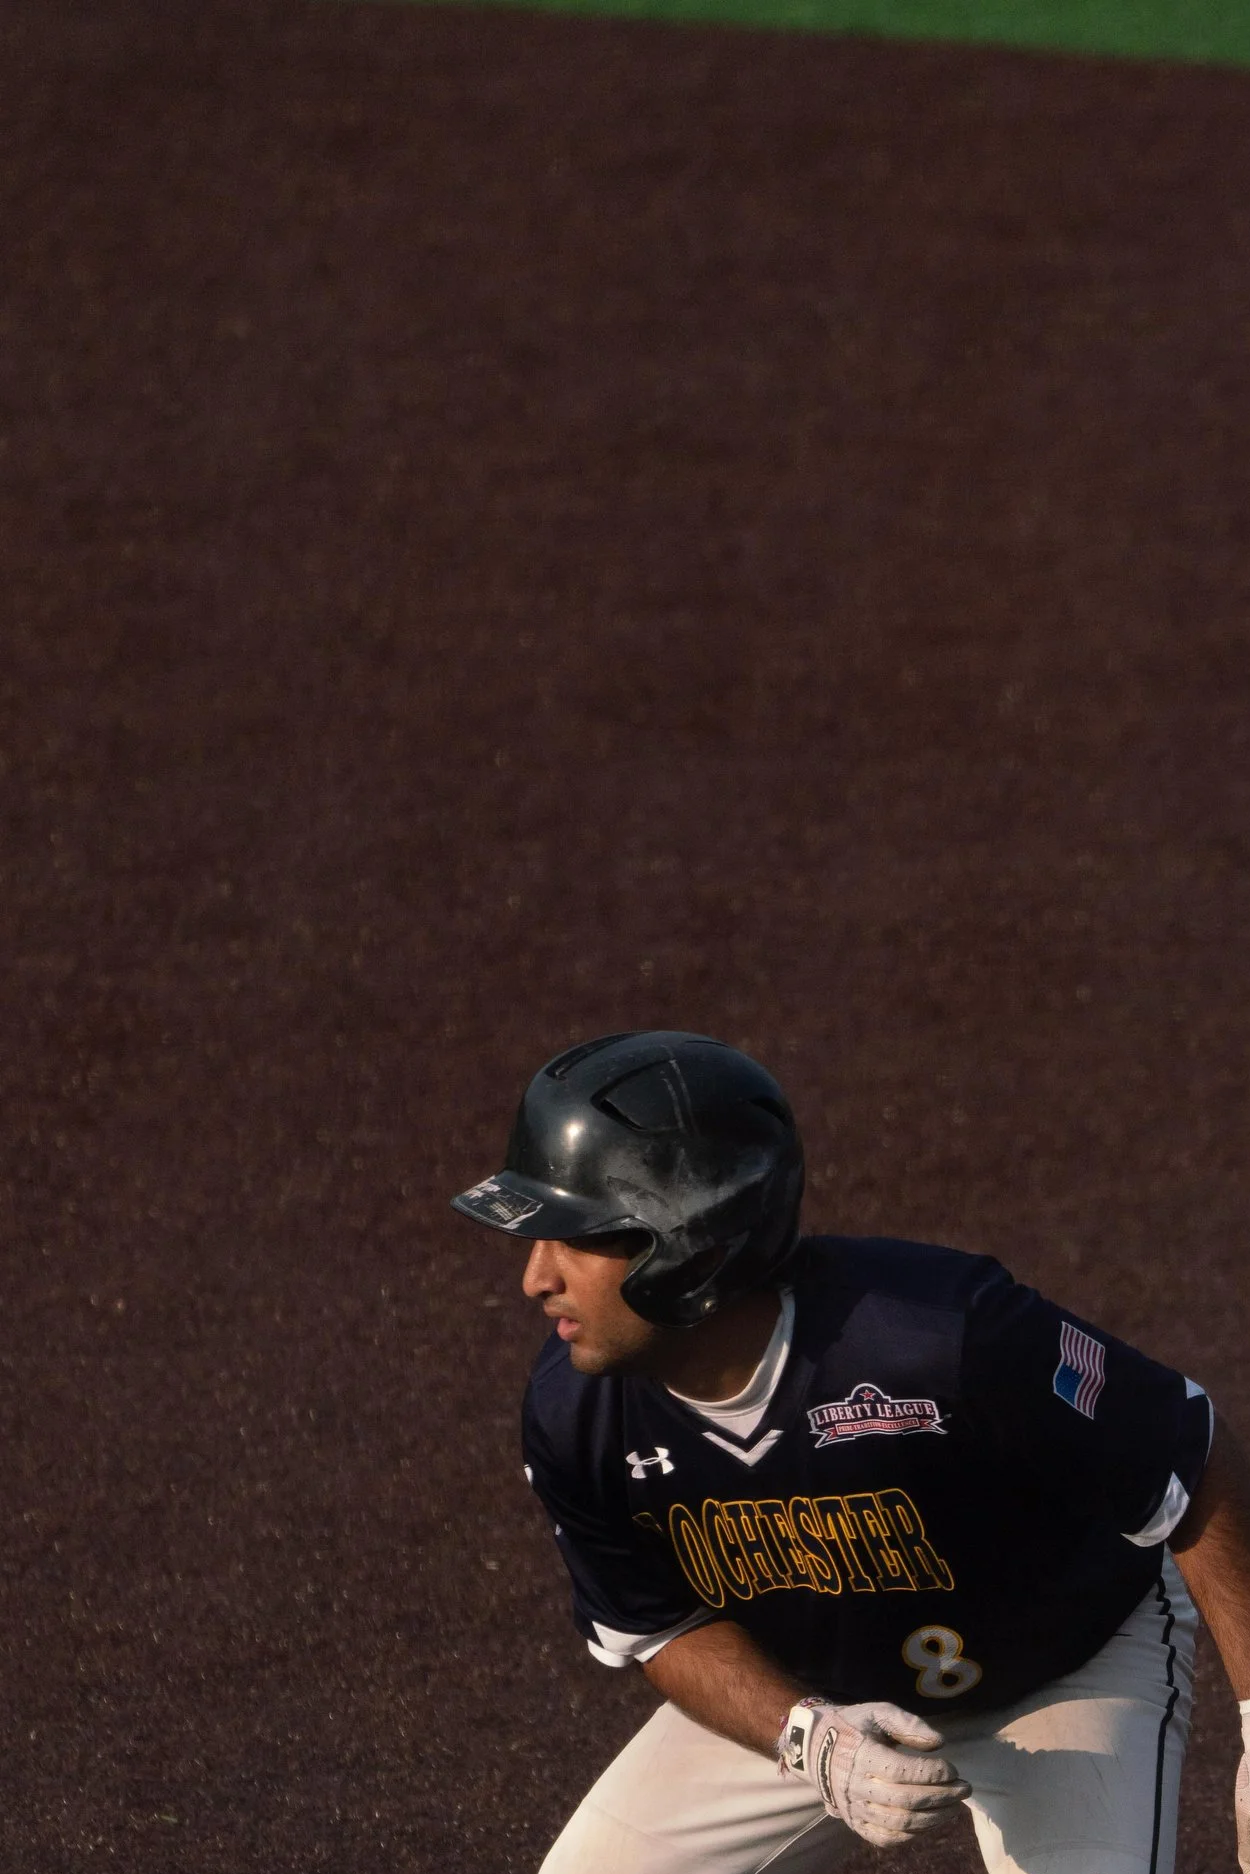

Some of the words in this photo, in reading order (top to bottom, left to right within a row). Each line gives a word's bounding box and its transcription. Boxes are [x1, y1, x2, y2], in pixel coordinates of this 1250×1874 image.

[814, 1403, 873, 1425] LIBERTY
[876, 1402, 935, 1418] LEAGUE
[632, 1488, 955, 1609] OCHESTER
[902, 1625, 982, 1698] 8
